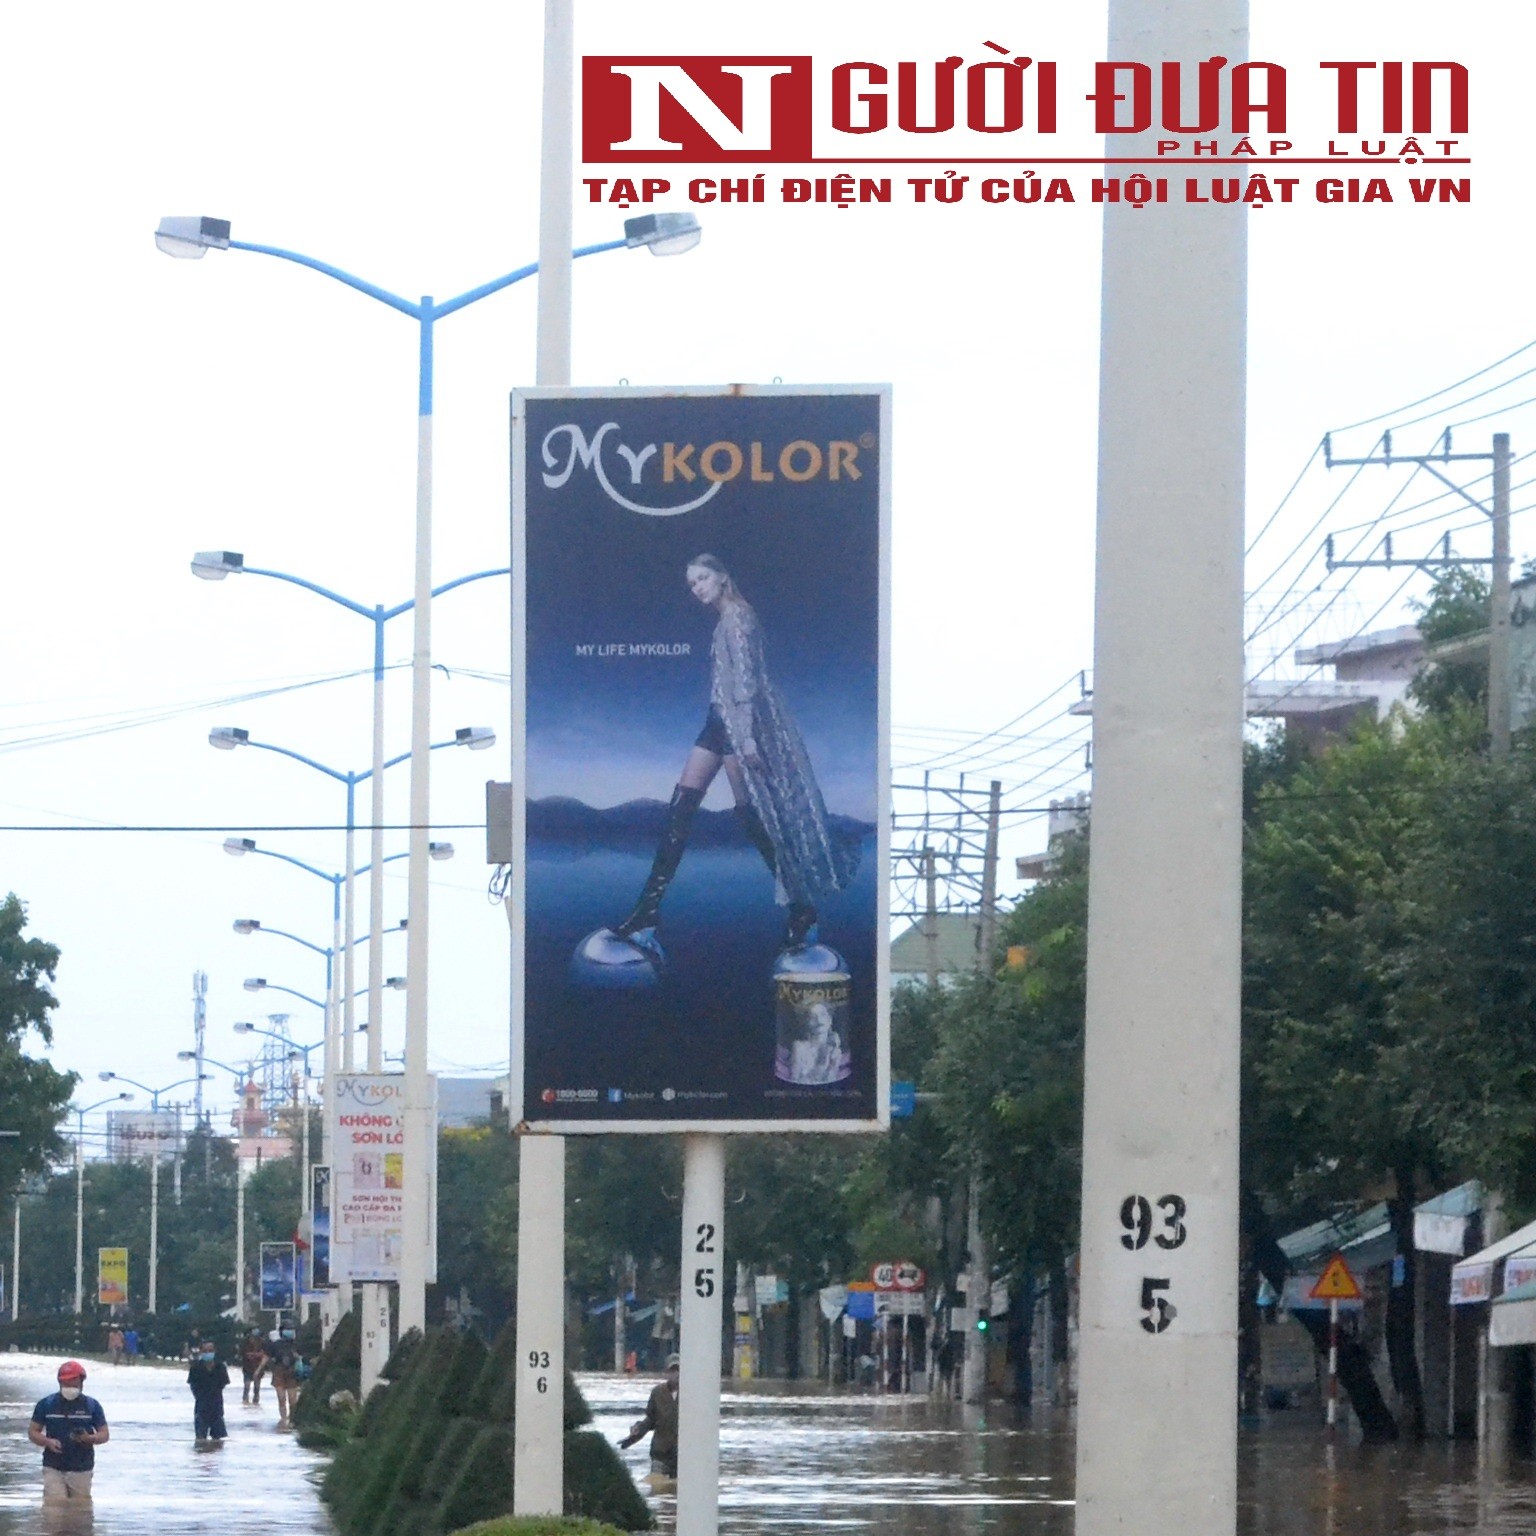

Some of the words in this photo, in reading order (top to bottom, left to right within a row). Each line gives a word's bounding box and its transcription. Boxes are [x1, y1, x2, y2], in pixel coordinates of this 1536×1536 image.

[576, 644, 595, 656] MY
[598, 644, 627, 656] LIFE
[630, 643, 691, 656] MYKOLOR
[339, 1112, 393, 1127] KHÔNG
[1120, 1194, 1187, 1250] 93
[696, 1223, 715, 1252] 2
[695, 1268, 714, 1298] 5
[1140, 1277, 1171, 1333] 5
[529, 1351, 550, 1369] 93
[536, 1377, 547, 1394] 6
